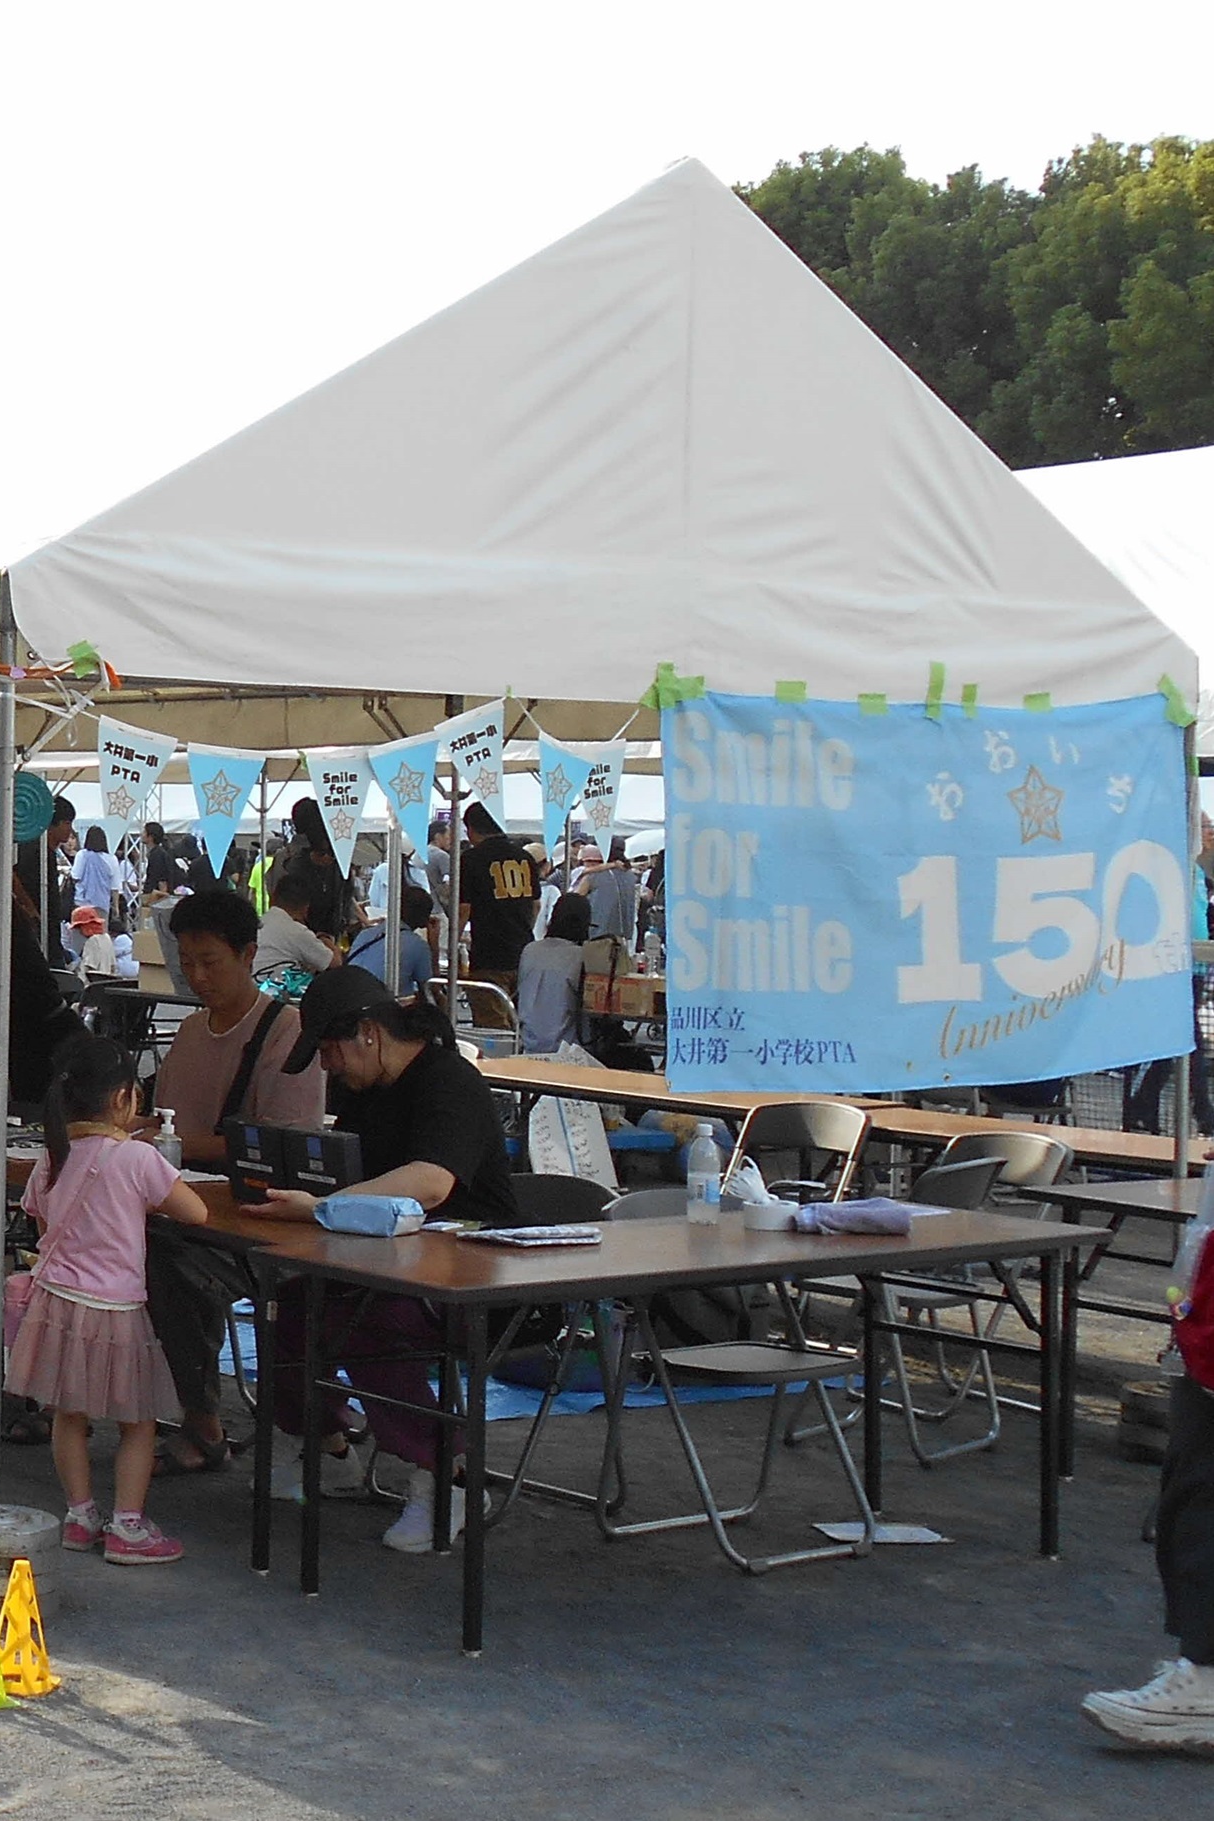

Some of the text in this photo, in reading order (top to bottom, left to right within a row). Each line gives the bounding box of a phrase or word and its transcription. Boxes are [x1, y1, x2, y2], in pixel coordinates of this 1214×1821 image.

[465, 747, 492, 767] PTA
[671, 710, 854, 811] Smile
[110, 764, 141, 784] PTA
[323, 771, 358, 784] Smile
[587, 776, 606, 788] for
[329, 784, 352, 795] for
[583, 785, 614, 800] Smile
[324, 794, 359, 807] Smile
[671, 811, 760, 898] for
[489, 859, 533, 899] 101
[897, 839, 1191, 1004] 150
[670, 899, 853, 994] Smile
[670, 1006, 746, 1031] 品川区立
